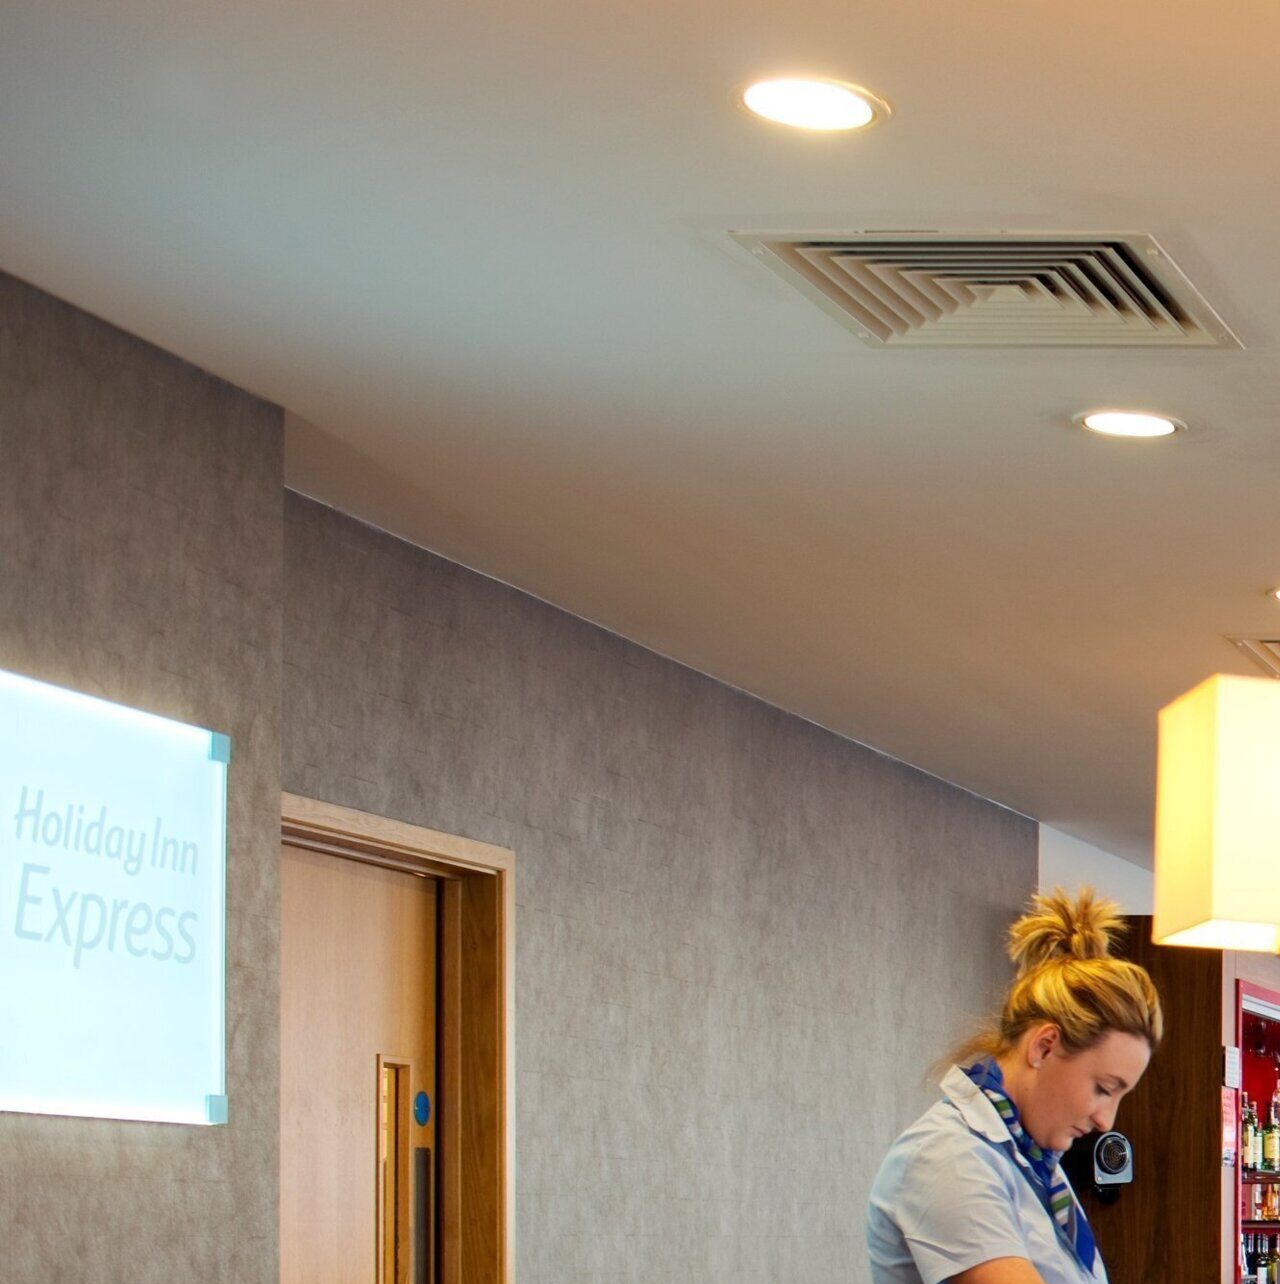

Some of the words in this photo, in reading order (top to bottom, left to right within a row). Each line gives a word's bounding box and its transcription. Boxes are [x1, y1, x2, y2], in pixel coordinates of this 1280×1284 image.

[14, 785, 146, 876] Holiday
[151, 816, 199, 875] Inn
[14, 862, 199, 970] Express
